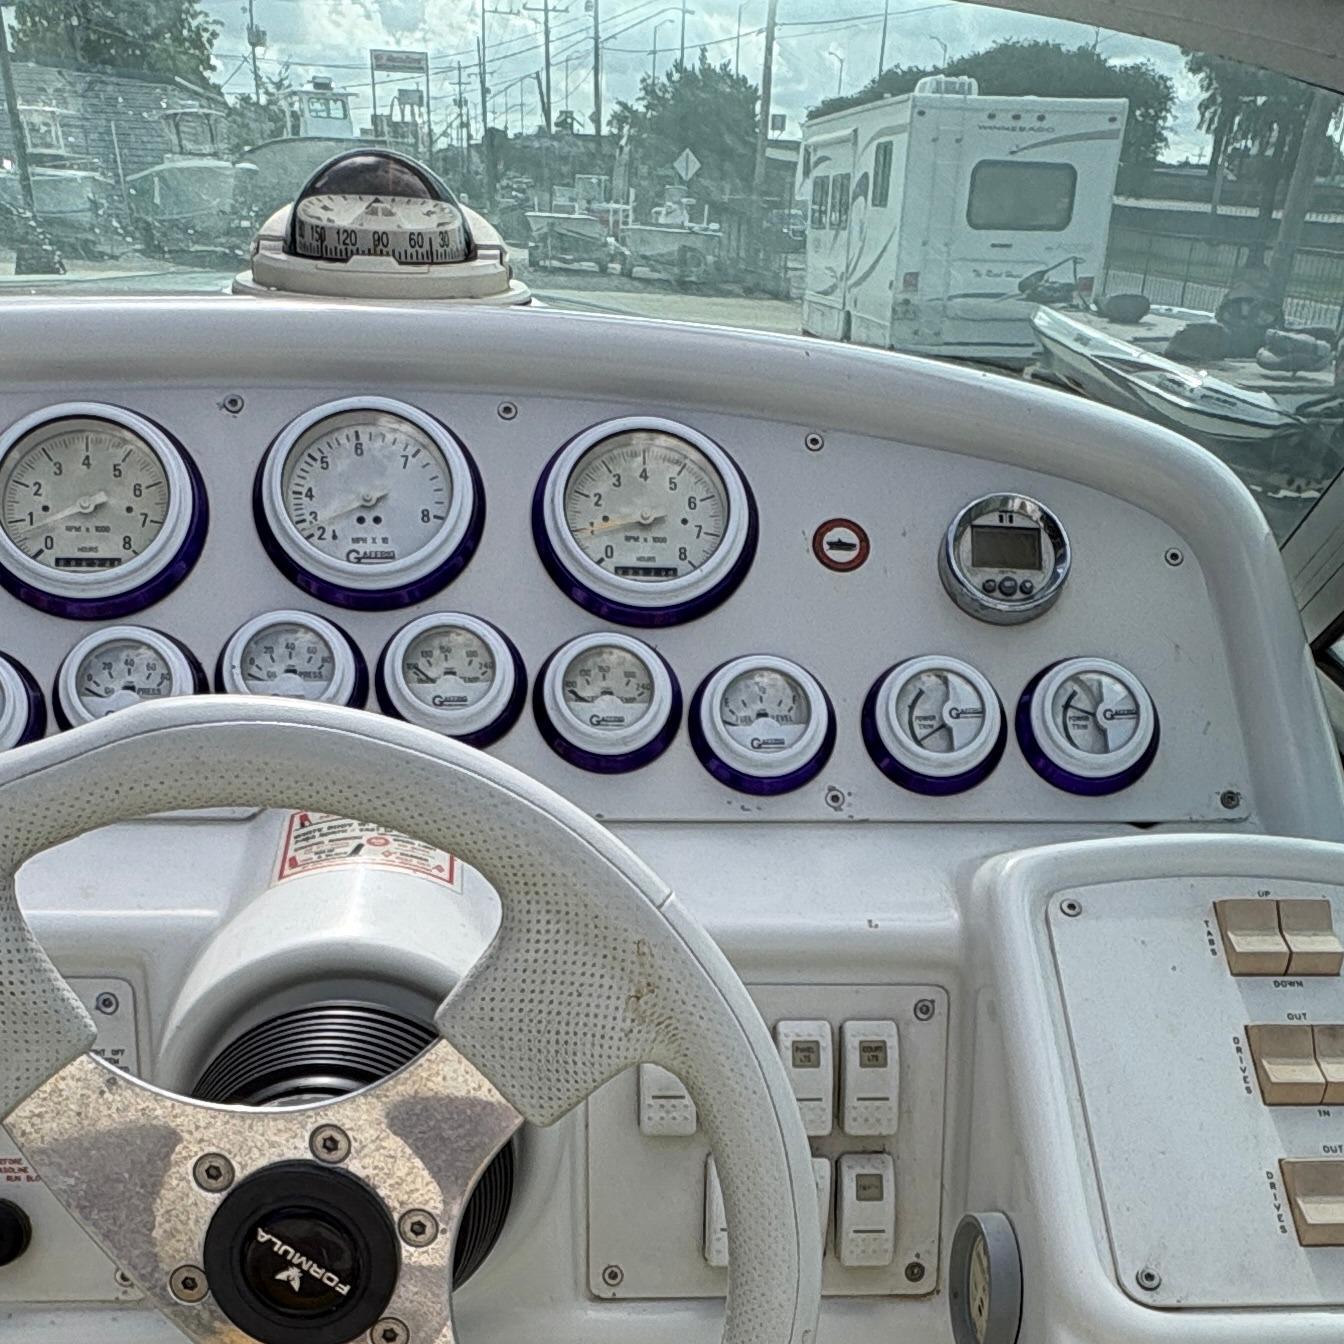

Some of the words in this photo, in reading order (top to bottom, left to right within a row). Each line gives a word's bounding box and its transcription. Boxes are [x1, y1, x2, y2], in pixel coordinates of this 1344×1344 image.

[978, 124, 1055, 134] WINNEBAGO
[311, 227, 326, 241] 150
[336, 230, 356, 245] 120
[373, 232, 389, 248] 90
[409, 232, 424, 248] 60
[439, 231, 449, 248] 30
[355, 443, 363, 456] 6
[82, 454, 91, 469] 4
[321, 456, 329, 470] 5
[401, 455, 408, 469] 7
[54, 463, 62, 476] 3
[113, 464, 122, 478] 5
[640, 468, 649, 481] 4
[613, 474, 621, 487] 3
[669, 477, 677, 491] 5
[33, 482, 42, 496] 2
[133, 484, 142, 497] 6
[305, 487, 314, 500] 4
[594, 493, 602, 507] 2
[688, 497, 696, 509] 6
[28, 512, 34, 526] 1
[140, 513, 148, 527] 7
[421, 509, 430, 523] 8
[317, 526, 326, 540] 2
[694, 525, 702, 538] 7
[45, 536, 53, 550] 0
[123, 536, 132, 550] 8
[605, 546, 613, 559] 0
[679, 548, 687, 561] 8
[264, 646, 274, 654] 20
[285, 642, 295, 650] 40
[103, 662, 112, 670] 20
[124, 659, 134, 667] 40
[918, 723, 934, 731] TRIM
[1204, 920, 1217, 956] TABS
[1273, 980, 1303, 988] DOWN
[795, 1046, 815, 1054] PANEL
[799, 1055, 811, 1063] LTS
[867, 1054, 879, 1062] LTS
[1232, 1037, 1253, 1095] DRIVES
[1323, 1145, 1344, 1153] OUT
[1266, 1171, 1288, 1234] DRIVES
[257, 1227, 351, 1296] FORMULA
